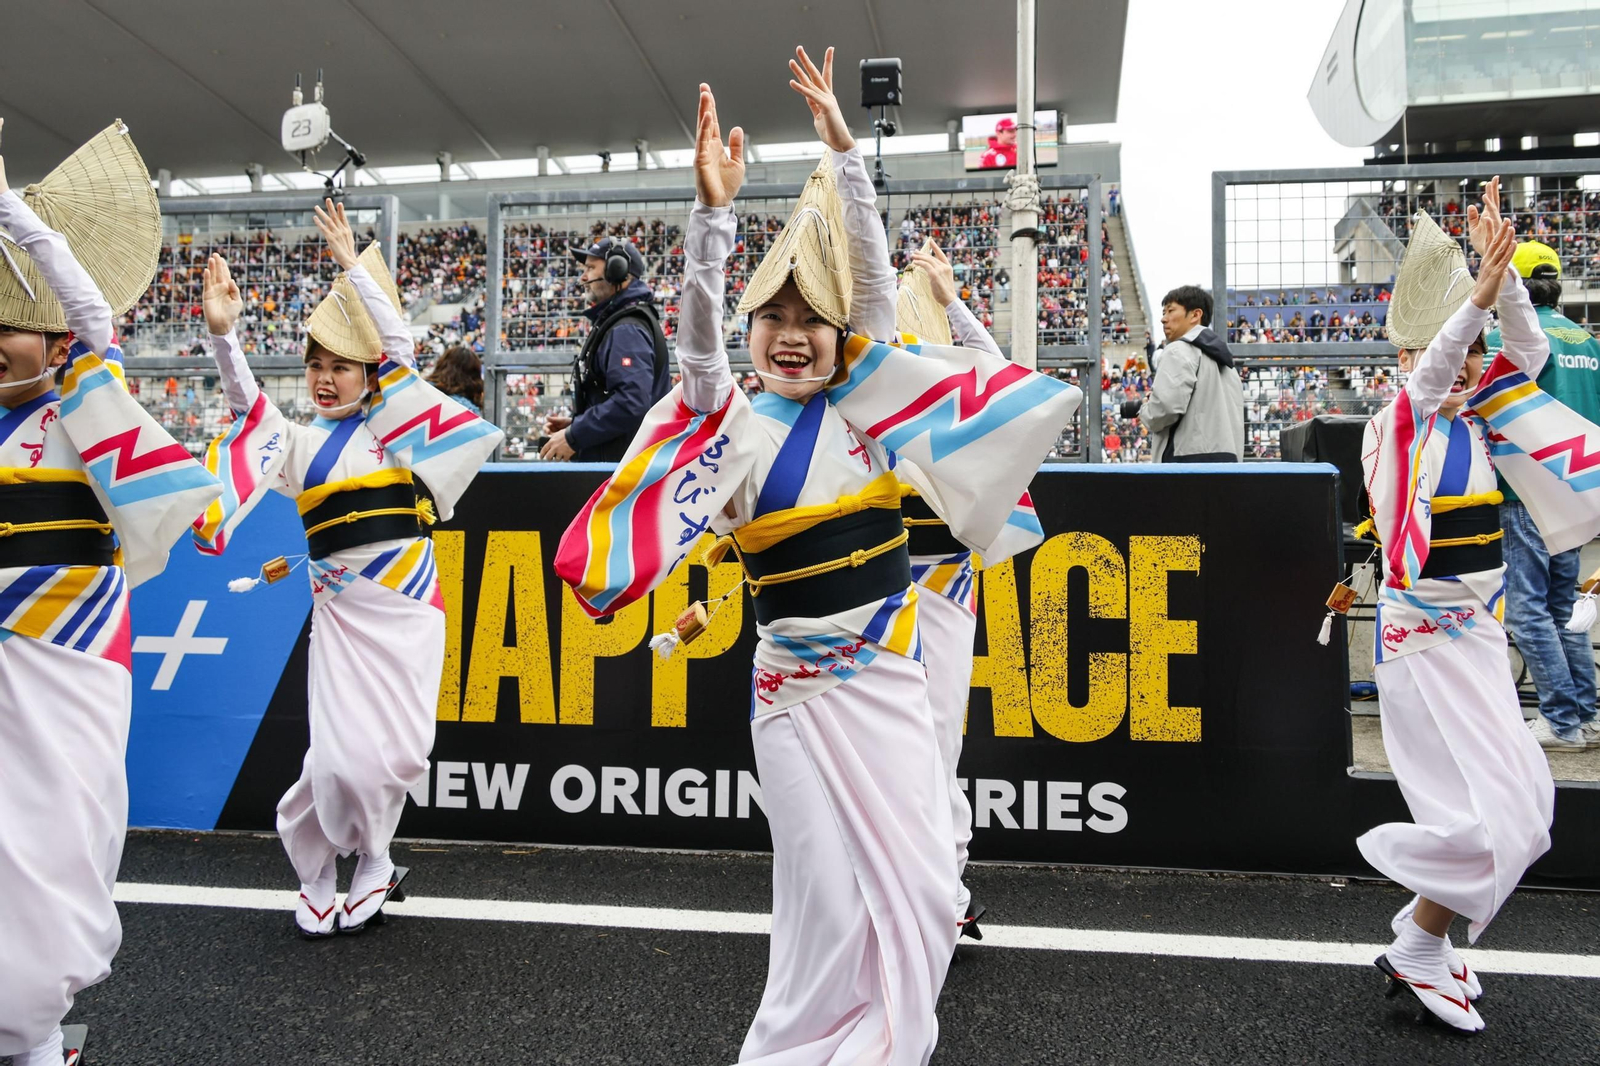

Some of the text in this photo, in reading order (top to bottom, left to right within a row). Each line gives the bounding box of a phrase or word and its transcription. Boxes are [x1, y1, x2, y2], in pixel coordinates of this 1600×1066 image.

[291, 118, 312, 138] 23
[962, 531, 1203, 743] ACE
[956, 778, 1129, 834] RIES
